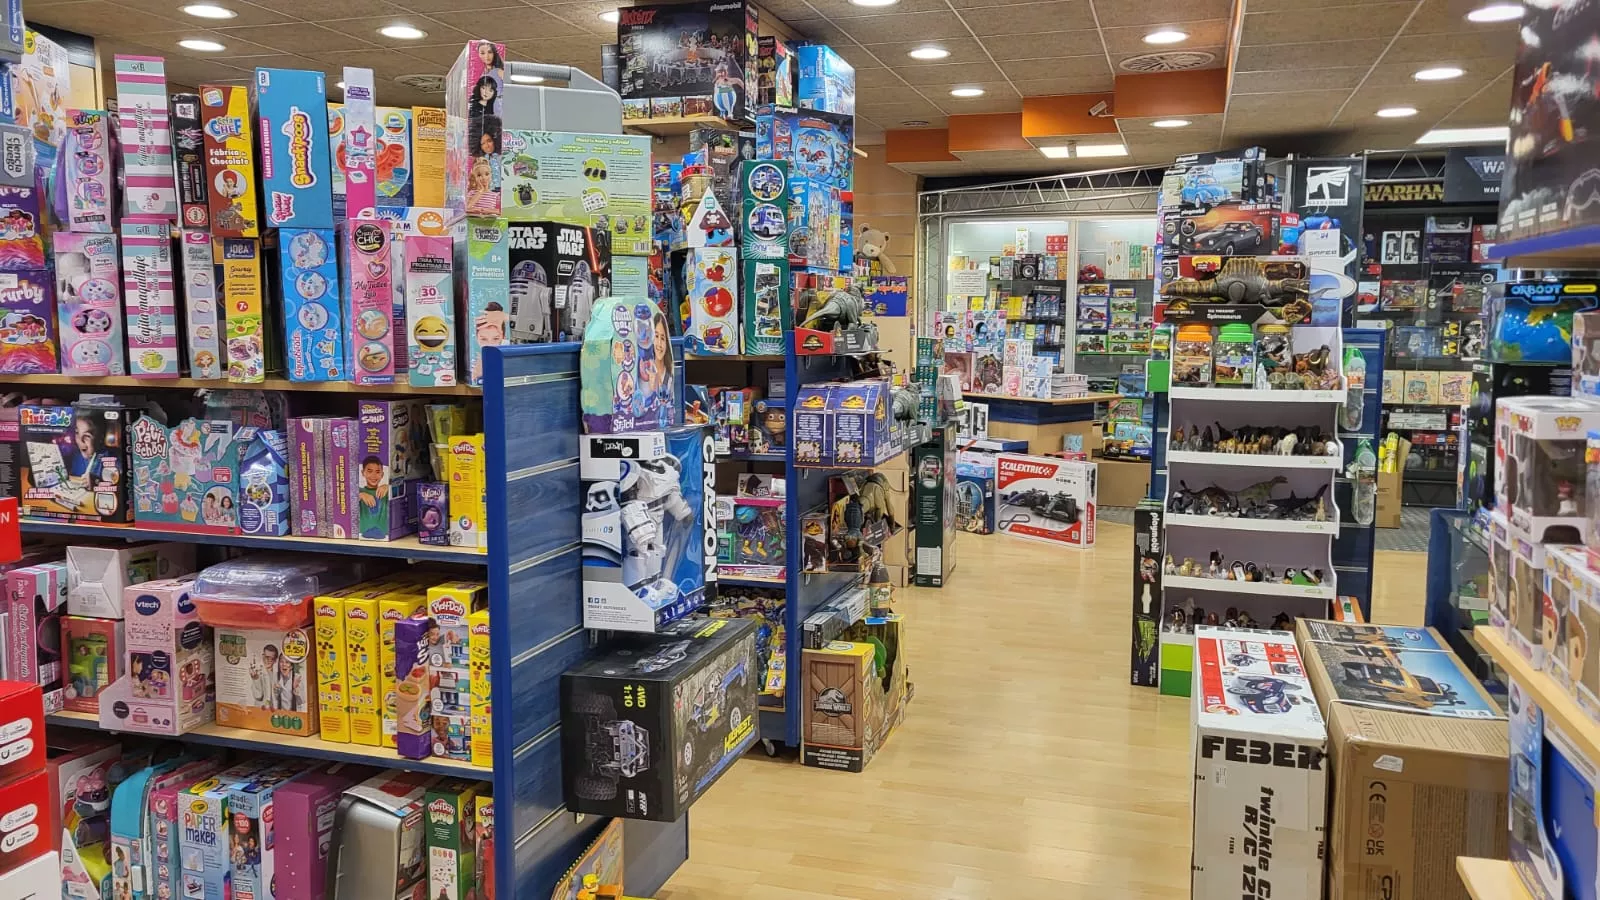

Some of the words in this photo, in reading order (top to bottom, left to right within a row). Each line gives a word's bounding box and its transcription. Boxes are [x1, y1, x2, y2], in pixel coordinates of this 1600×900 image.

[709, 2, 742, 12] playmobil
[210, 118, 242, 136] CHEF
[210, 157, 250, 165] Chocolate
[1181, 208, 1205, 216] playmobil
[357, 236, 381, 245] CHIC
[557, 228, 585, 242] STAR
[558, 240, 585, 256] WARS
[491, 254, 501, 263] 8+
[134, 256, 150, 311] maquillaje
[1511, 284, 1563, 298] ORBOOT
[421, 287, 437, 297] 30
[135, 313, 151, 345] Cajita
[291, 331, 304, 377] Aquabeads
[135, 440, 167, 460] school
[1000, 461, 1045, 476] SCALEXTRIC
[703, 435, 718, 583] CRAZON
[603, 526, 614, 534] 09
[1150, 512, 1160, 553] playmobil
[136, 599, 160, 611] vtech
[316, 606, 336, 617] Play-Doh
[348, 608, 368, 618] Play-Doh
[431, 599, 465, 616] Play-Doh
[623, 684, 634, 708] 1:10
[636, 684, 647, 709] 4WD
[833, 702, 852, 713] WORLD
[1202, 736, 1323, 771] FEBER
[428, 800, 455, 816] Play-Doh
[184, 812, 217, 830] PAPER
[1258, 786, 1277, 872] twinkle
[185, 827, 216, 847] maker
[1243, 804, 1259, 857] R/C
[1366, 839, 1375, 856] CA
[1375, 841, 1385, 856] UK
[1242, 863, 1257, 900] 12
